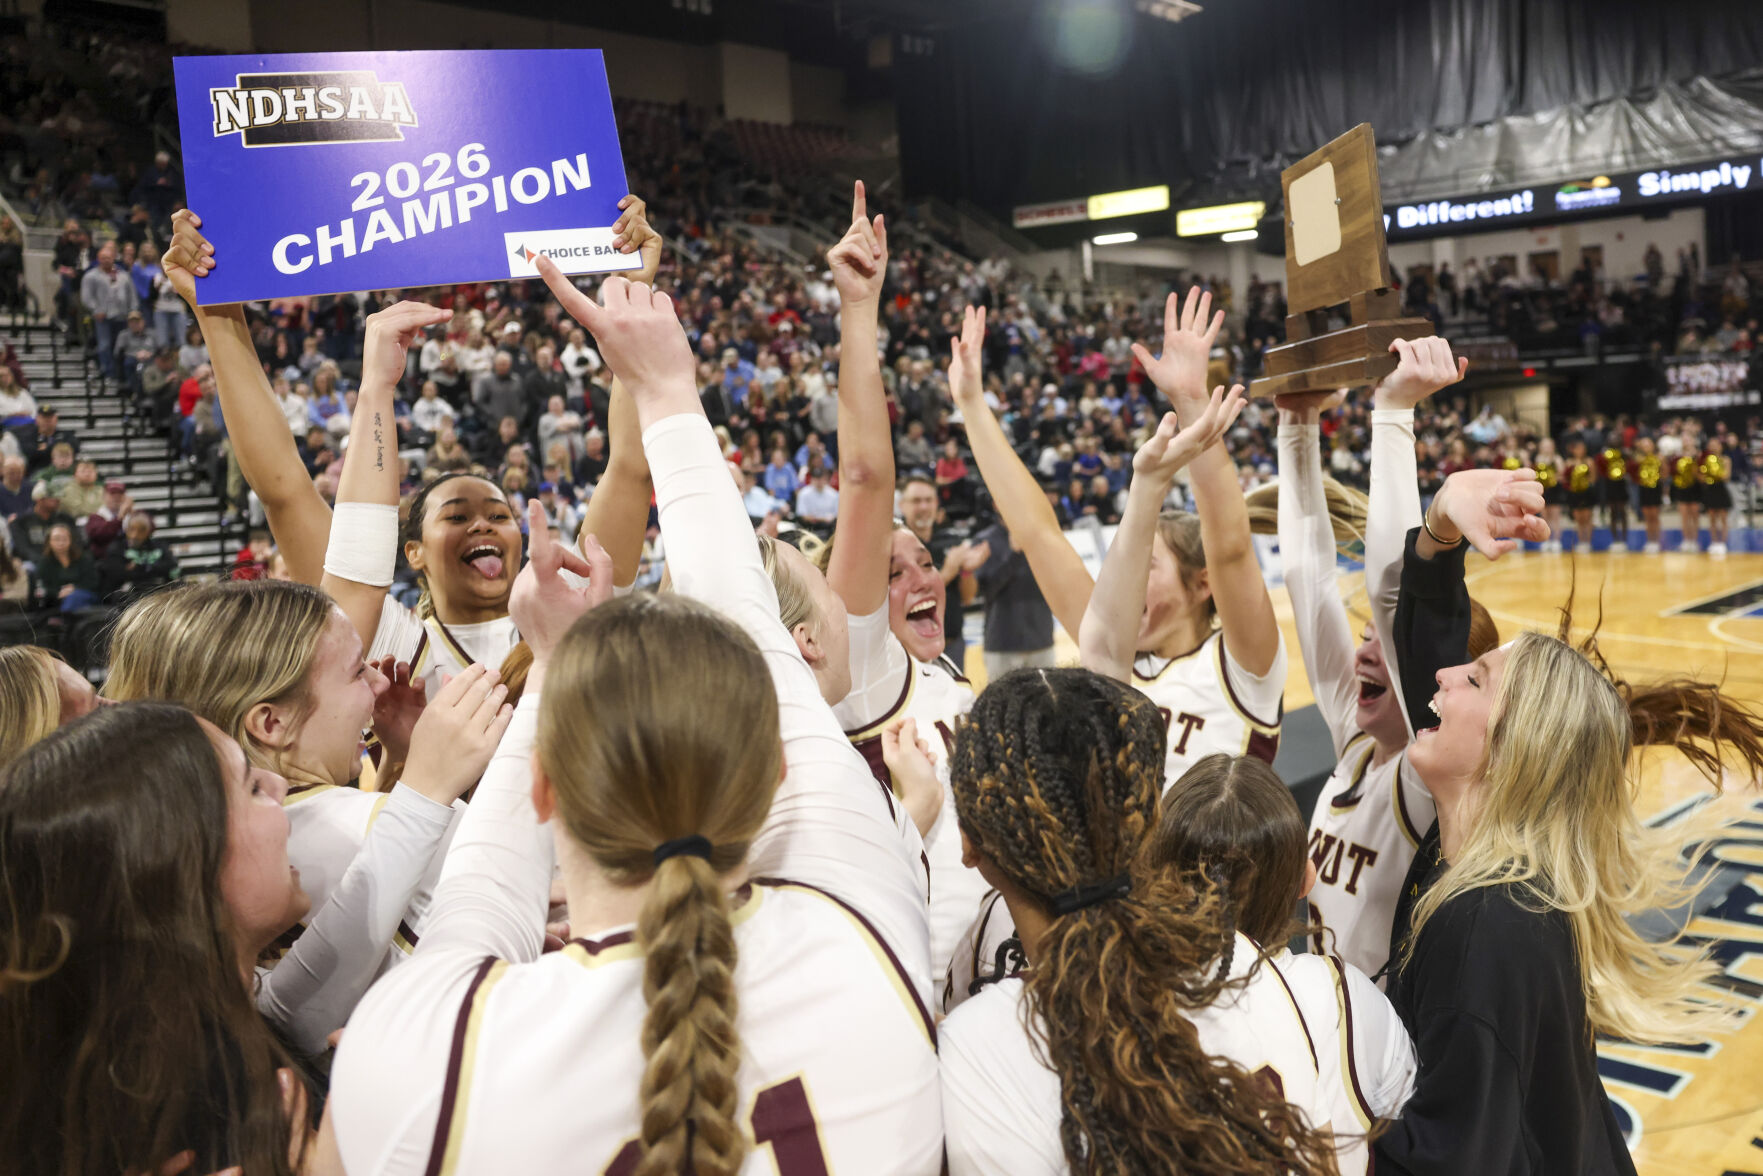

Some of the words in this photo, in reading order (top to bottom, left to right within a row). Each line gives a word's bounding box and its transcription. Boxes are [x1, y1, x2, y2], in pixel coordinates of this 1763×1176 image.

[213, 85, 416, 134] NDHSAA
[350, 142, 491, 213] 2026
[1638, 161, 1752, 197] Simply
[271, 152, 592, 275] CHAMPION
[1397, 190, 1534, 228] Different!
